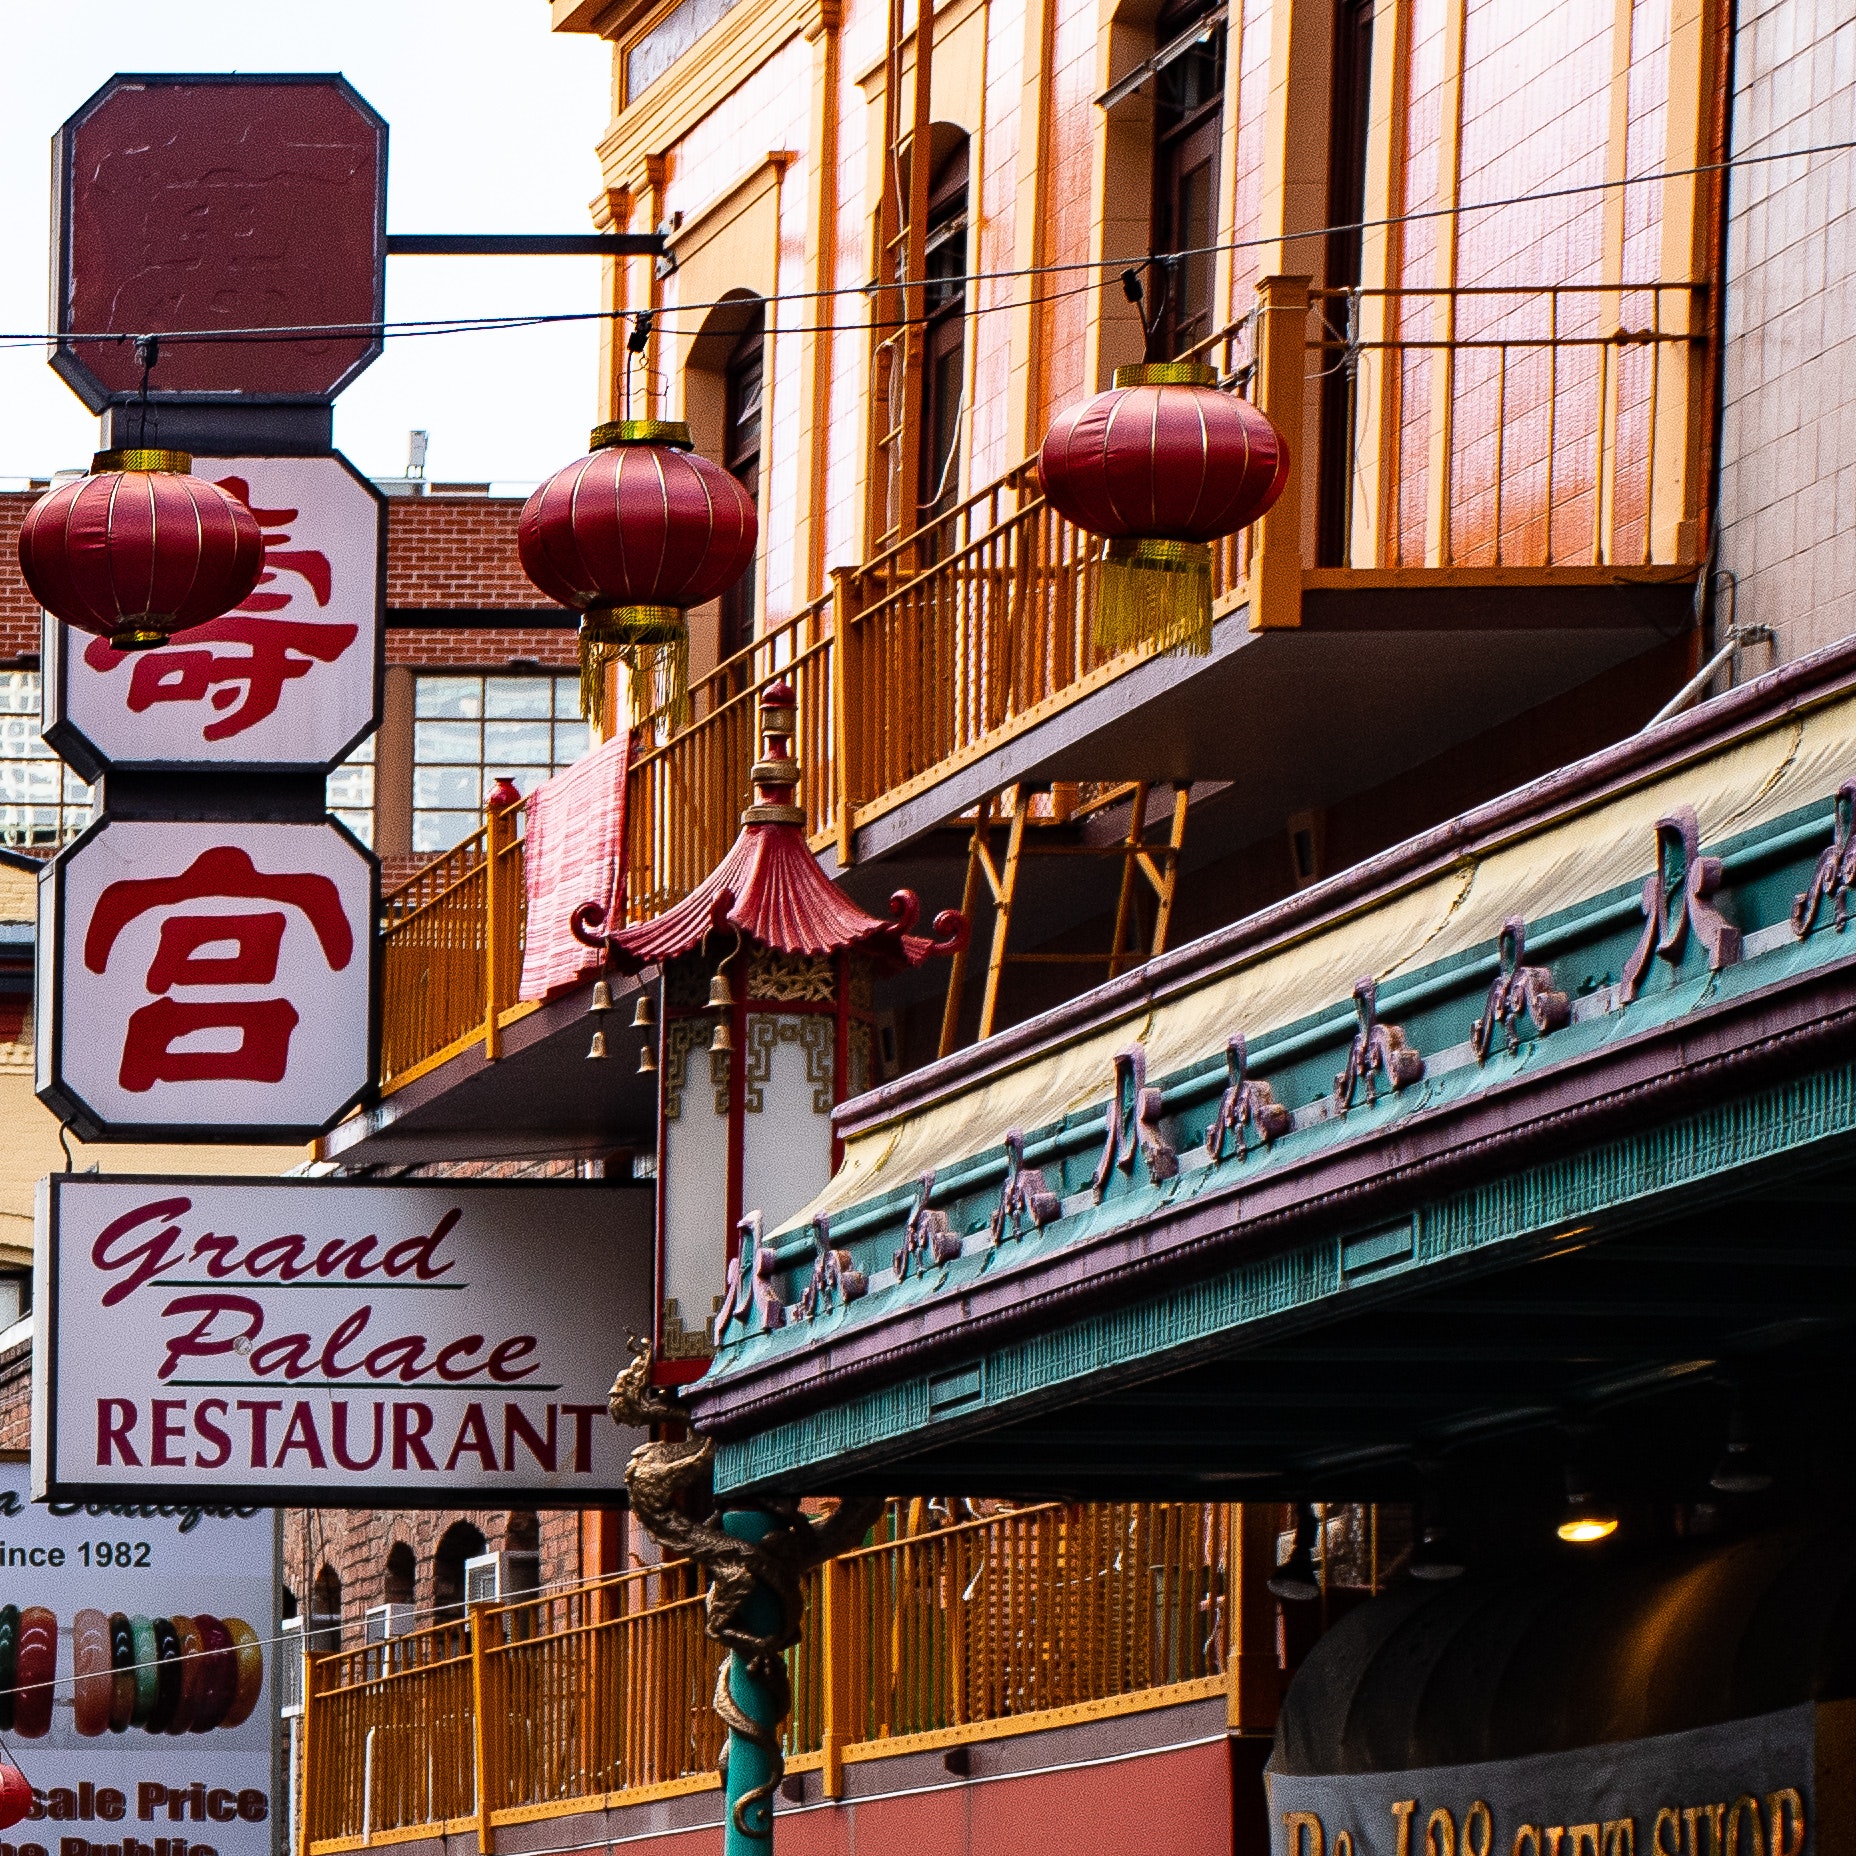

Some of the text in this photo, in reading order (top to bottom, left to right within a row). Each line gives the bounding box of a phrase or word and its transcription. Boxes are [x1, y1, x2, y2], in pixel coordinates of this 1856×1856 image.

[94, 1197, 463, 1306] Grand
[158, 1294, 540, 1382] Palace
[98, 1400, 611, 1471] RESTAURANT
[81, 1542, 150, 1567] 1982
[139, 1783, 268, 1822] Price
